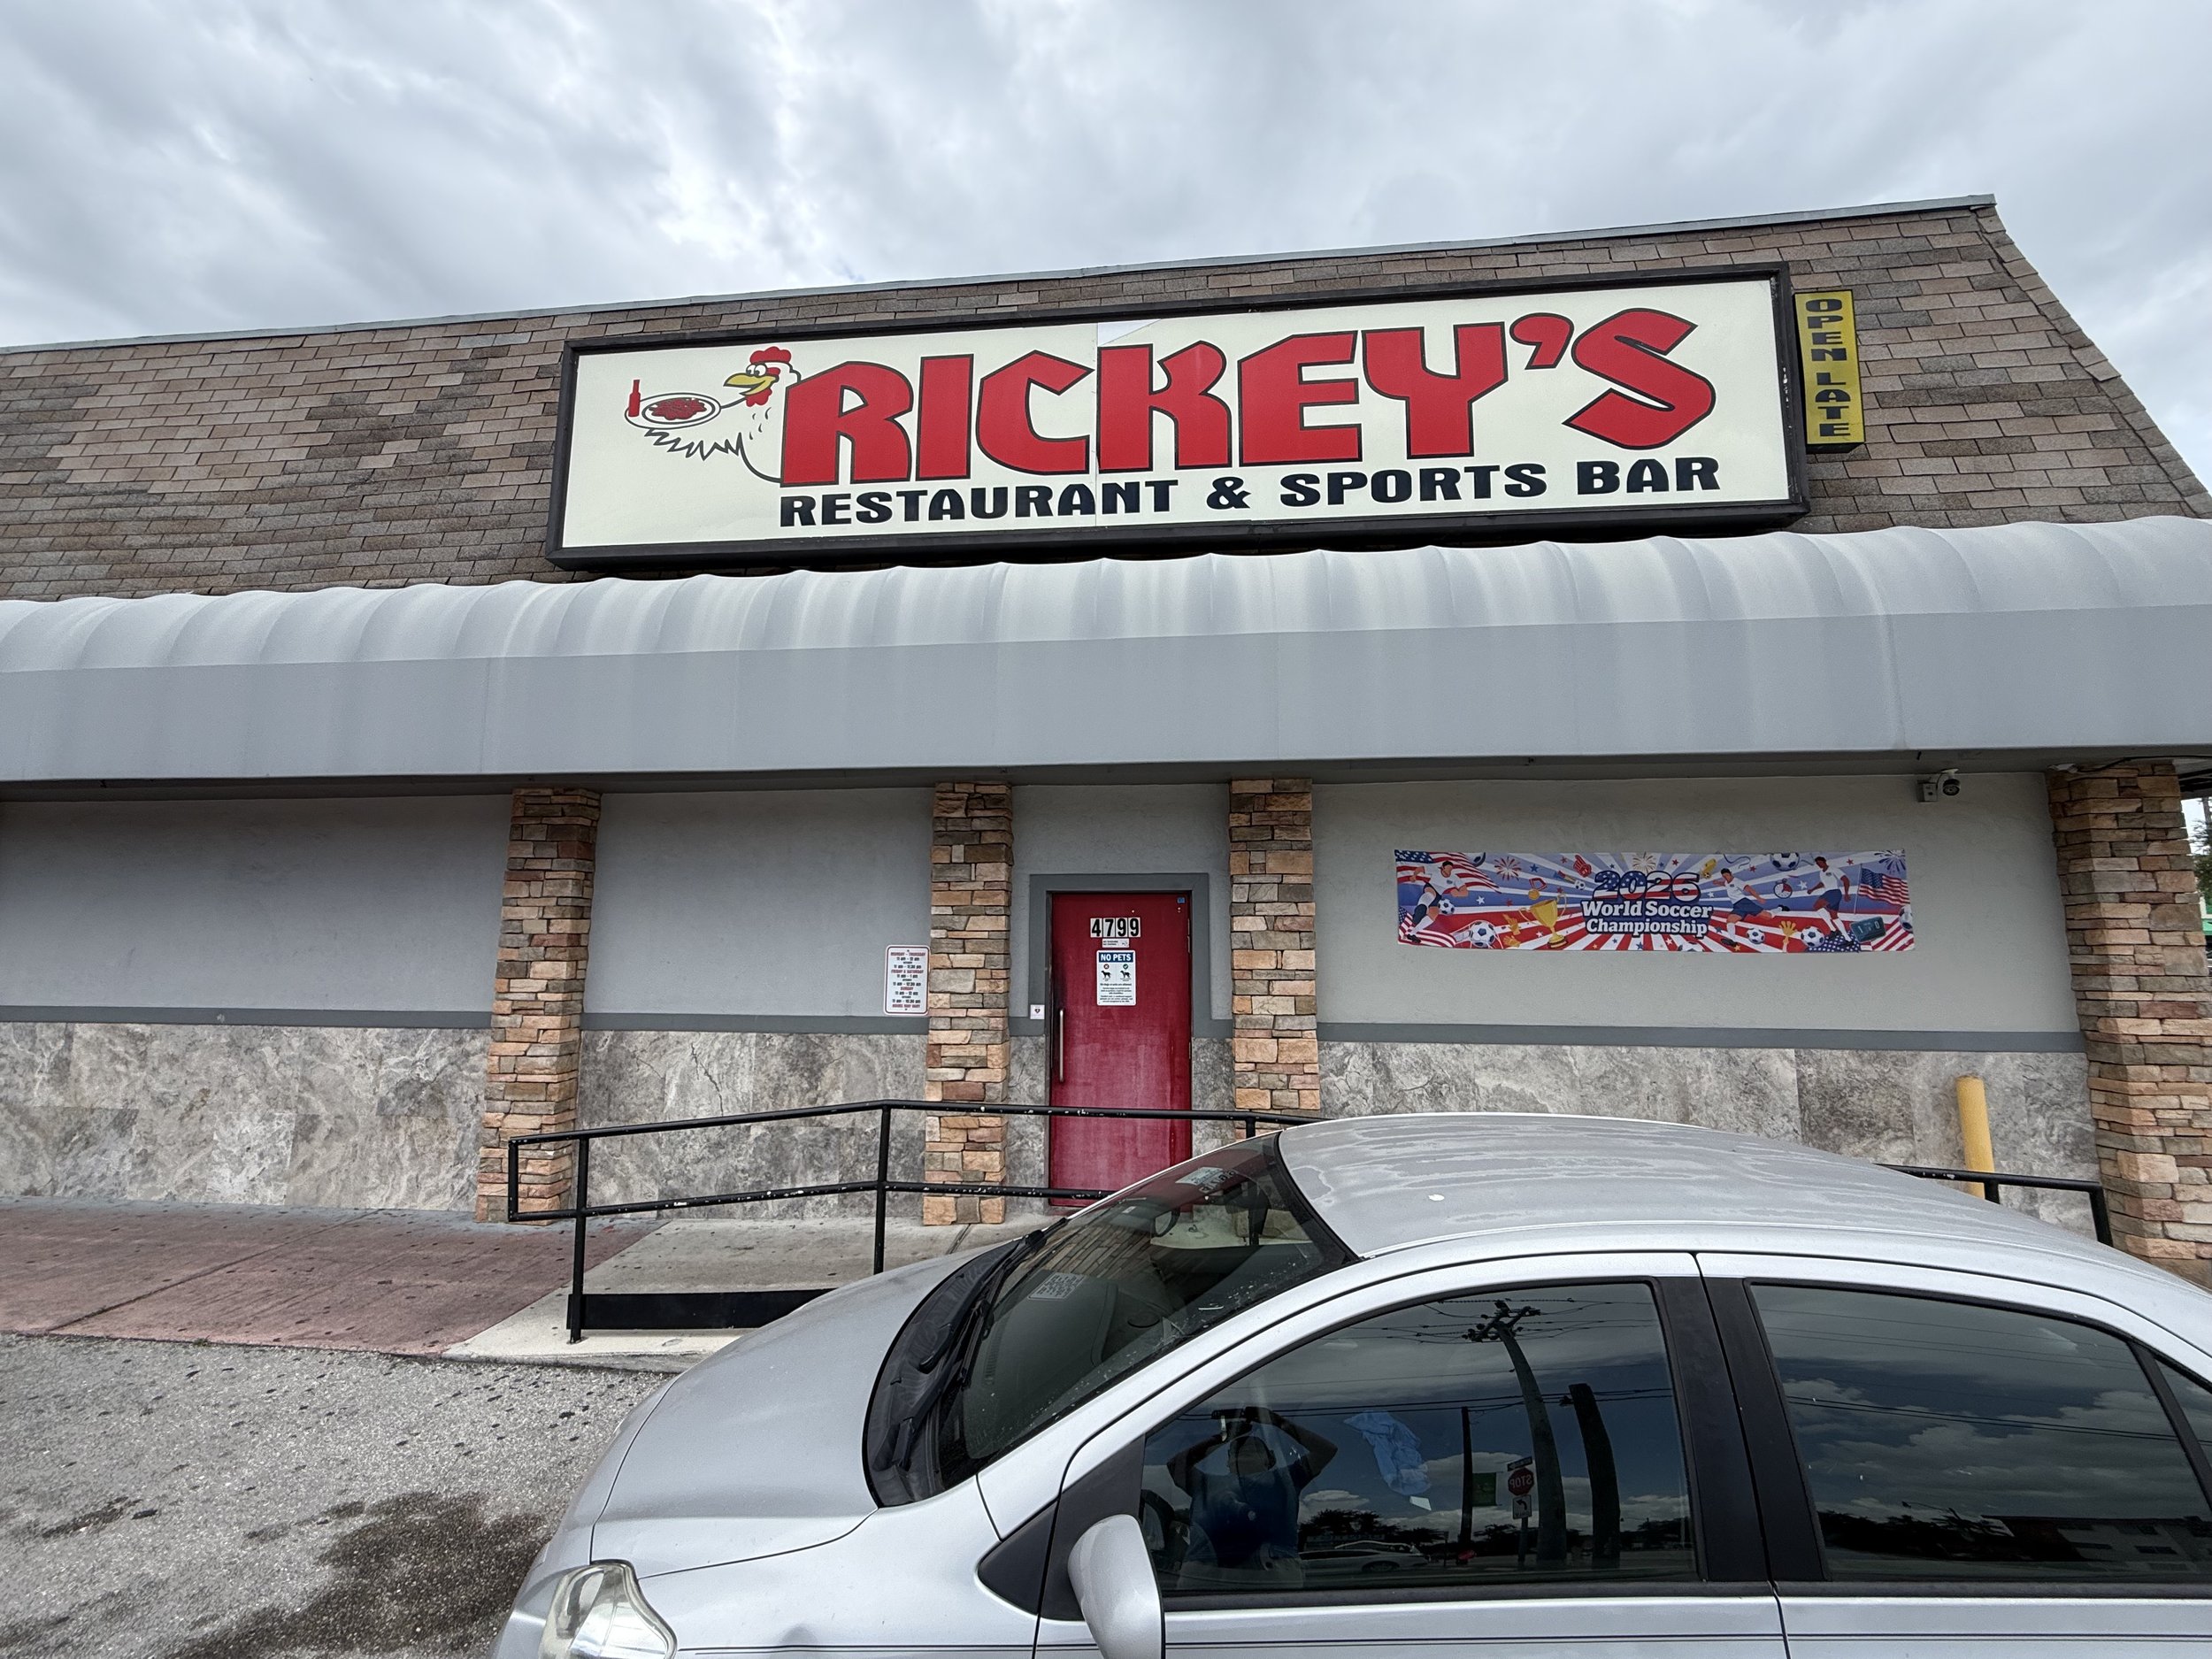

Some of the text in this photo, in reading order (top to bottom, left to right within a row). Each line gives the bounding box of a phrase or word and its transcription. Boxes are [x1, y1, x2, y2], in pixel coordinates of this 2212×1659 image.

[1806, 299, 1851, 436] OPEN LATE
[780, 307, 1716, 488] RICKEY'S
[779, 456, 1721, 528] RESTAURANT & SPORTS BAR
[1592, 871, 1701, 902] 2026
[1582, 901, 1713, 918] World Soccer
[1091, 918, 1140, 937] 4799
[1586, 918, 1708, 936] Championship
